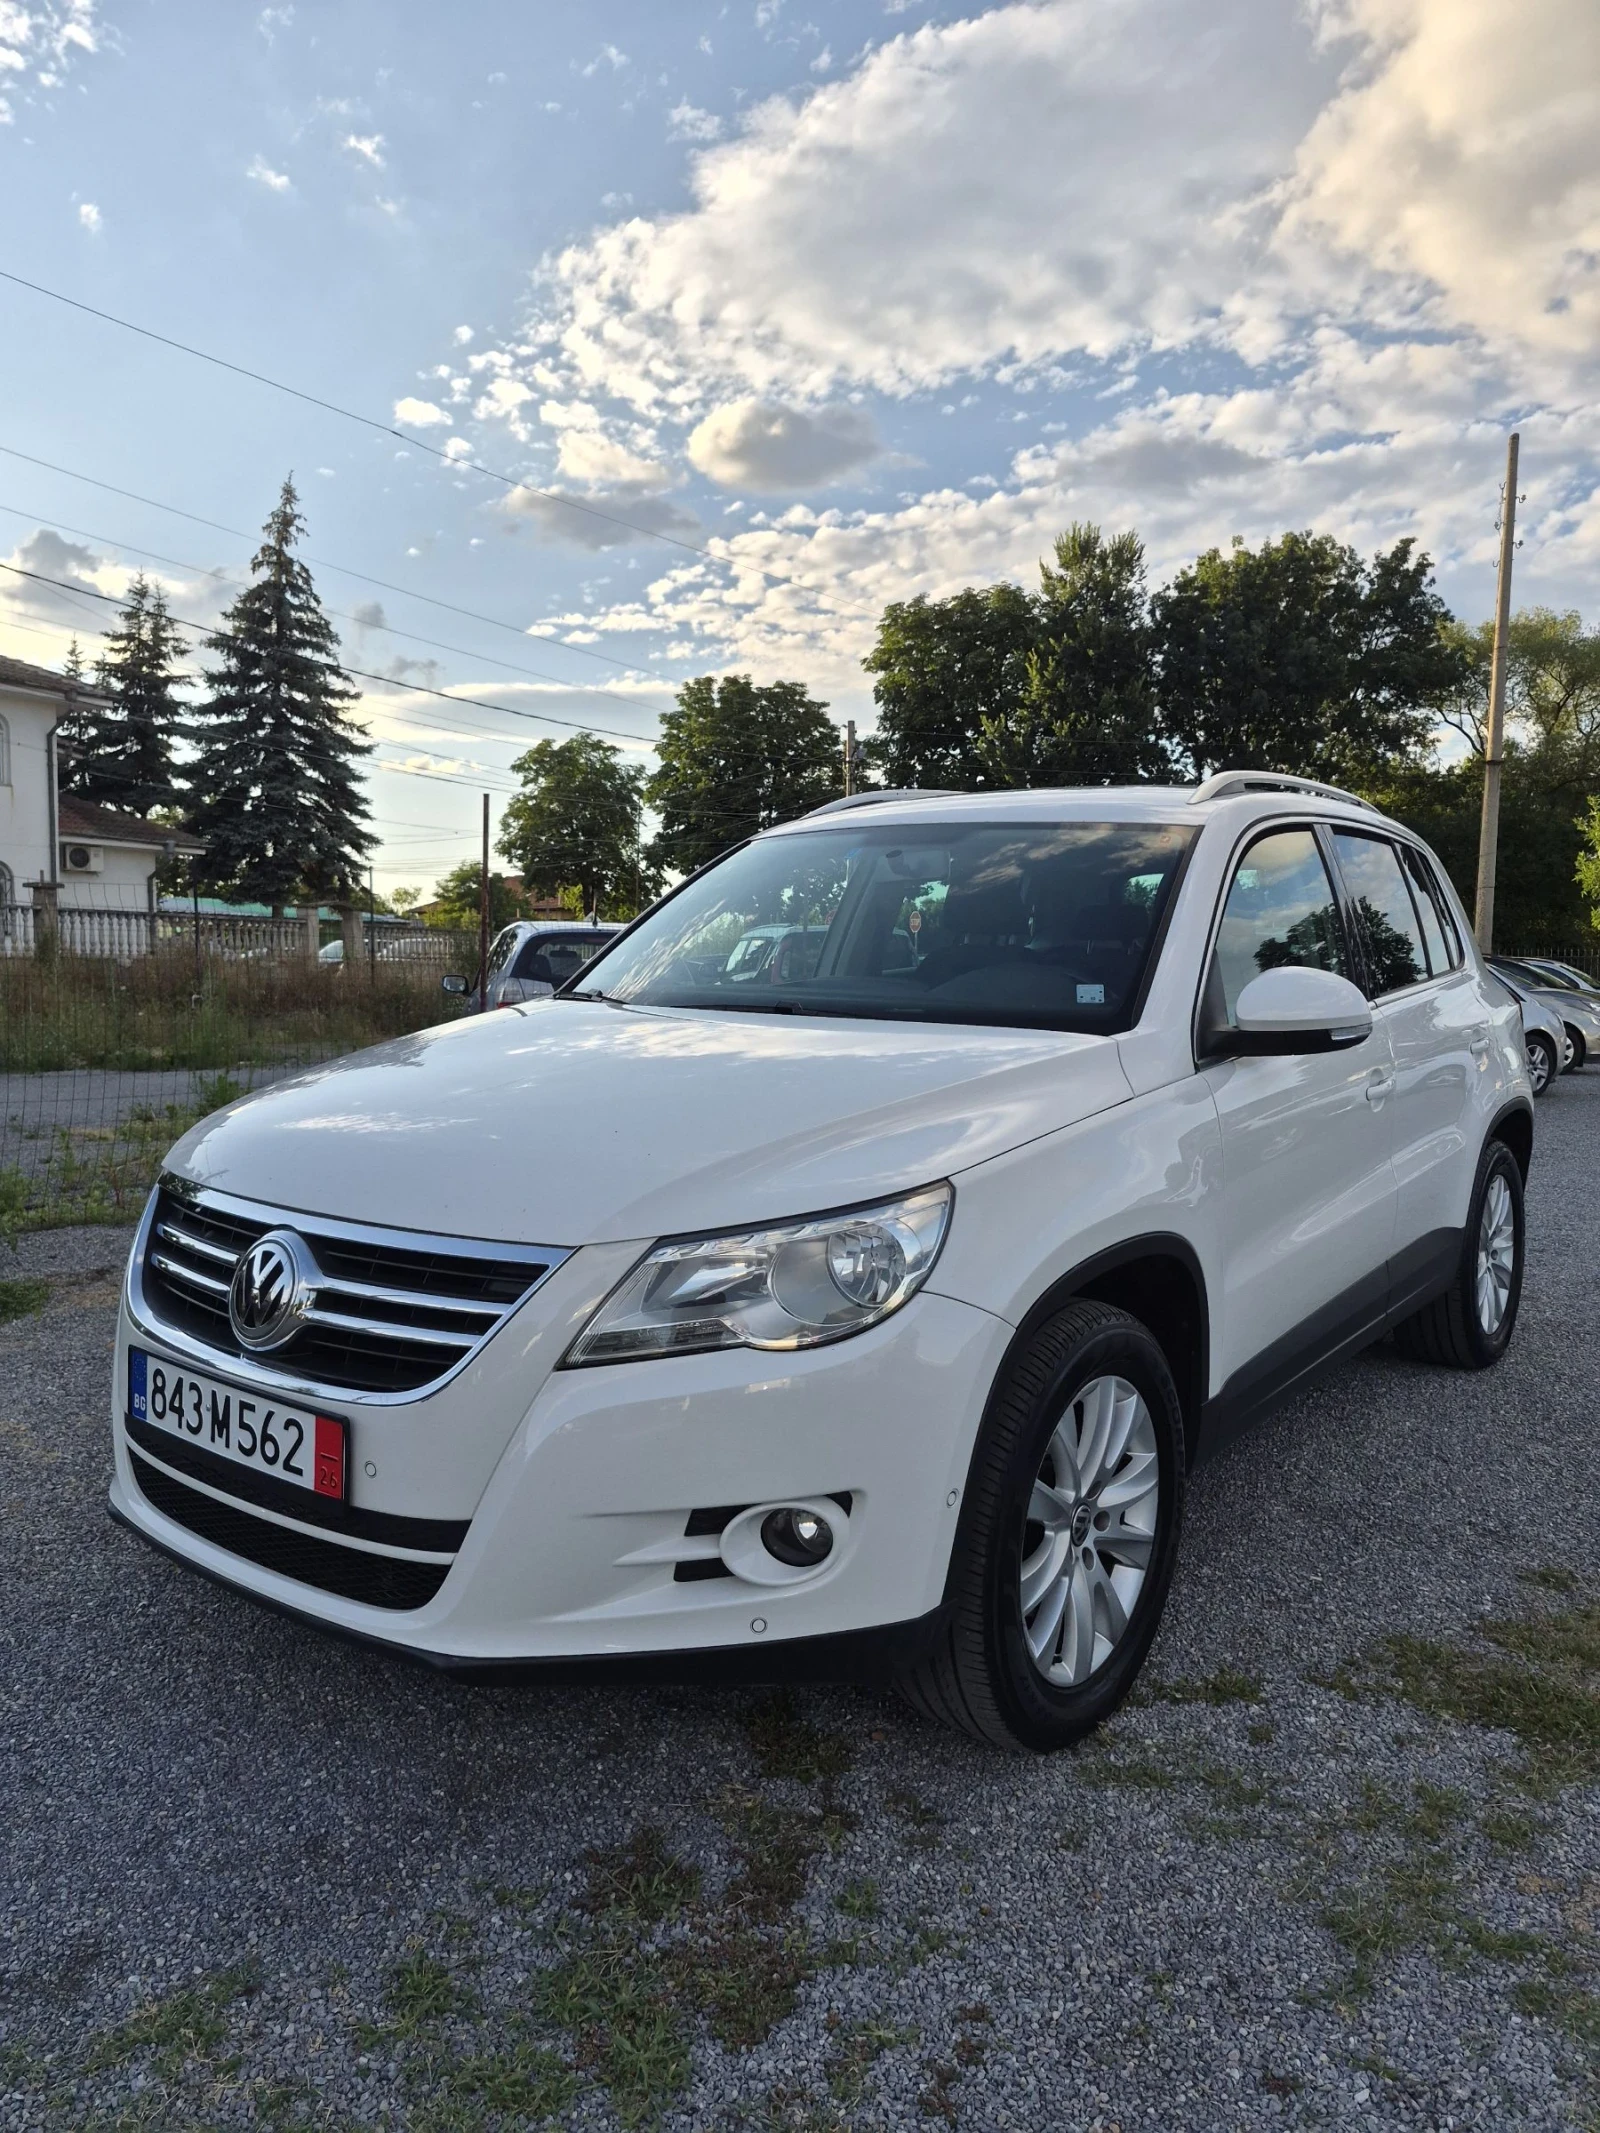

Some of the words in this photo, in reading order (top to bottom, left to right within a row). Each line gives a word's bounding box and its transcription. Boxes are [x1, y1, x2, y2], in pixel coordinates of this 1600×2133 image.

[233, 1242, 294, 1337] VW
[134, 1393, 146, 1412] BG
[320, 1466, 337, 1489] 26
